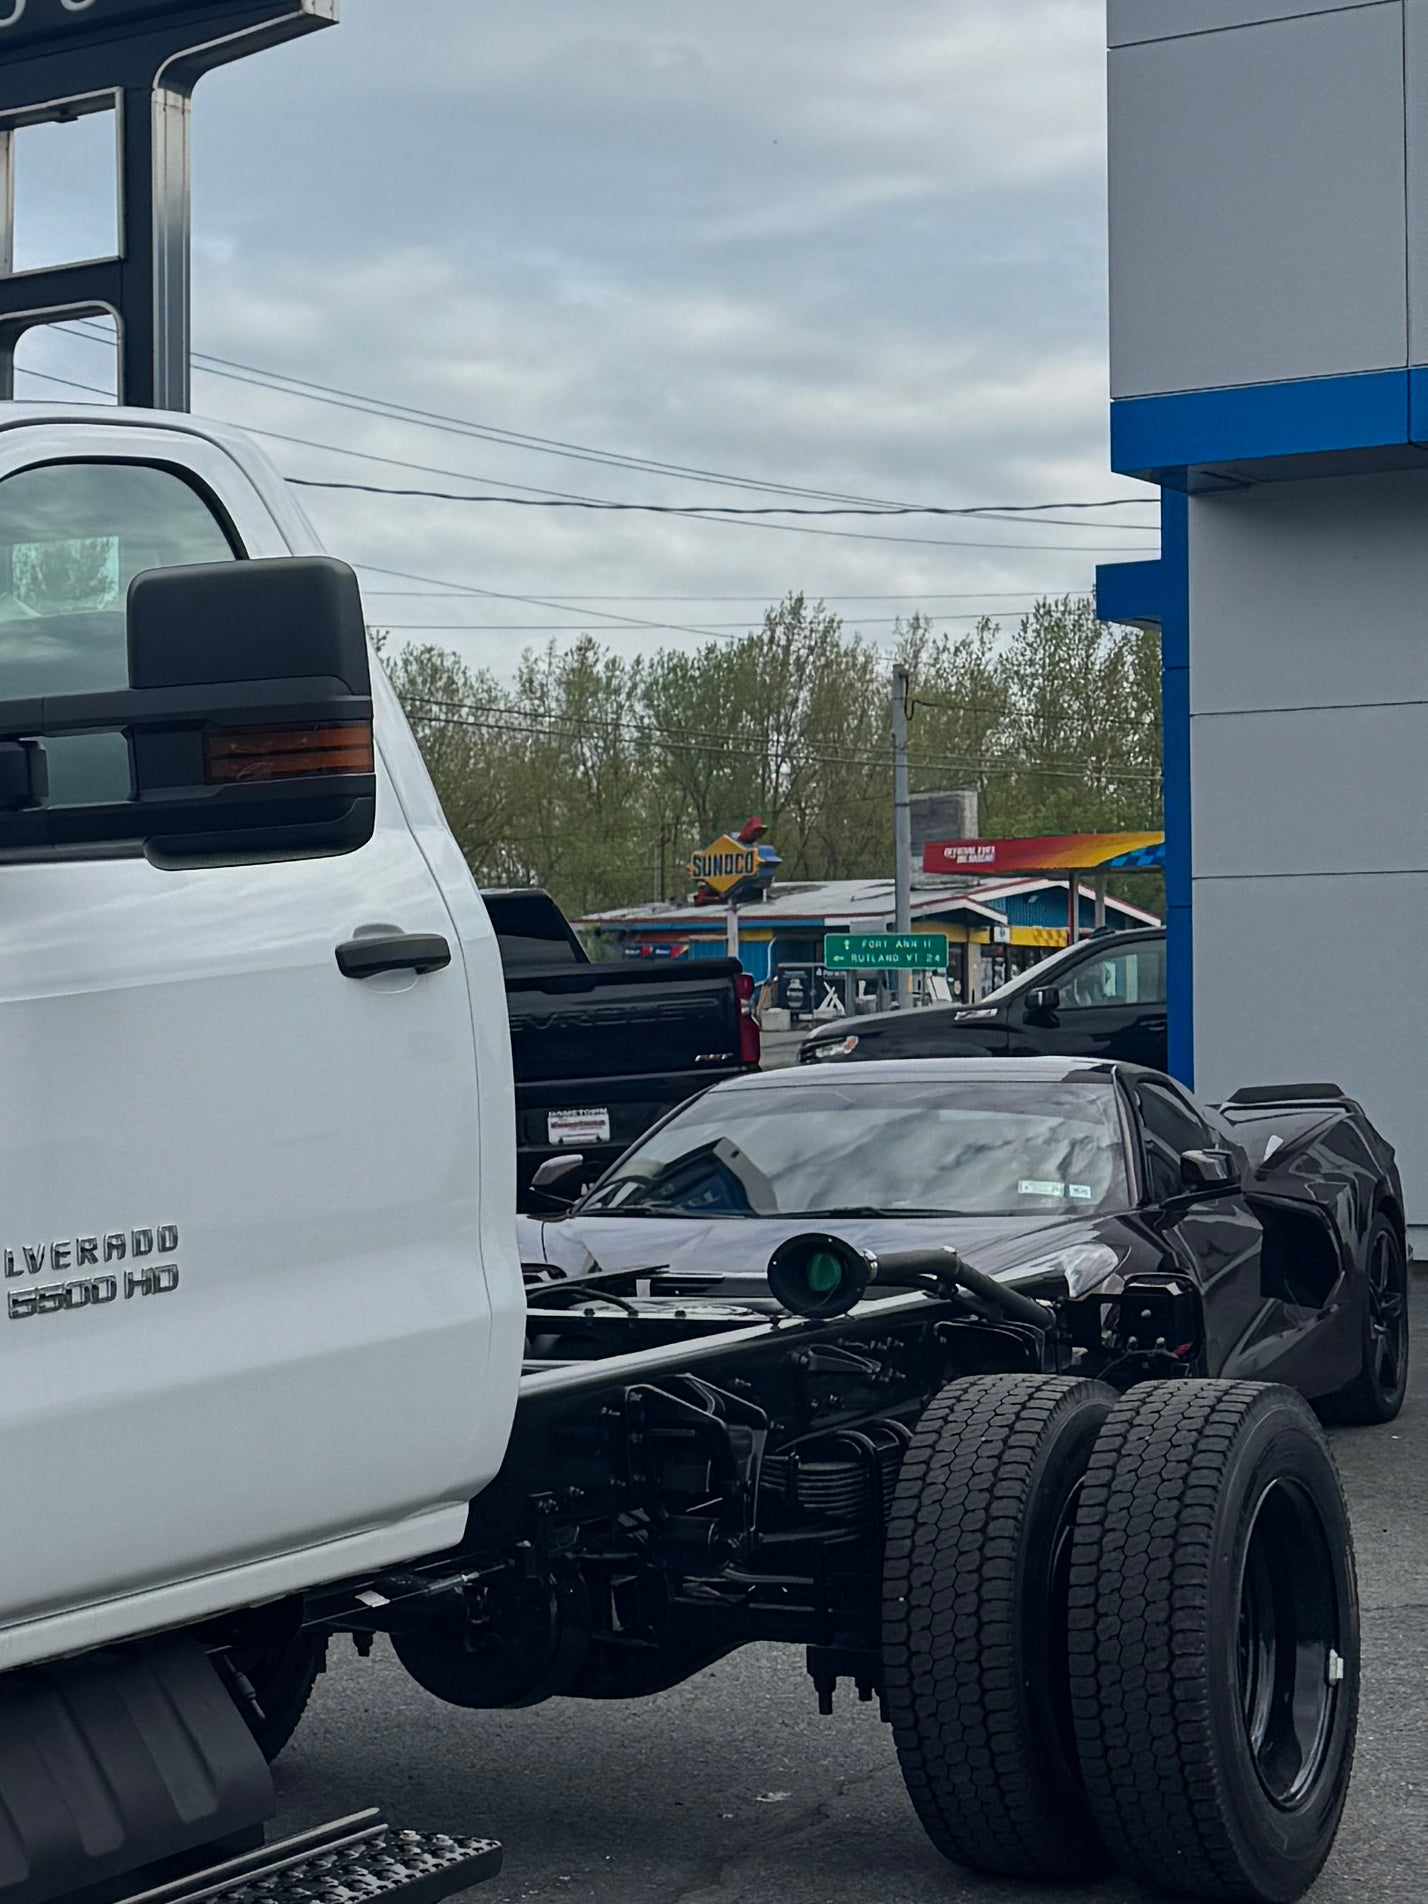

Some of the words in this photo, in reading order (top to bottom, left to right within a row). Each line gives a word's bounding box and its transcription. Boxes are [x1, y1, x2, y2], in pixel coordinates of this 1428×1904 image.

[692, 851, 753, 878] SUNOCO
[861, 939, 887, 949] FORT
[895, 939, 918, 949] ANN
[850, 953, 900, 963] RUTLAND
[906, 953, 918, 963] VT
[926, 953, 941, 963] 24
[7, 1275, 118, 1320] 5500
[123, 1263, 180, 1300] HD
